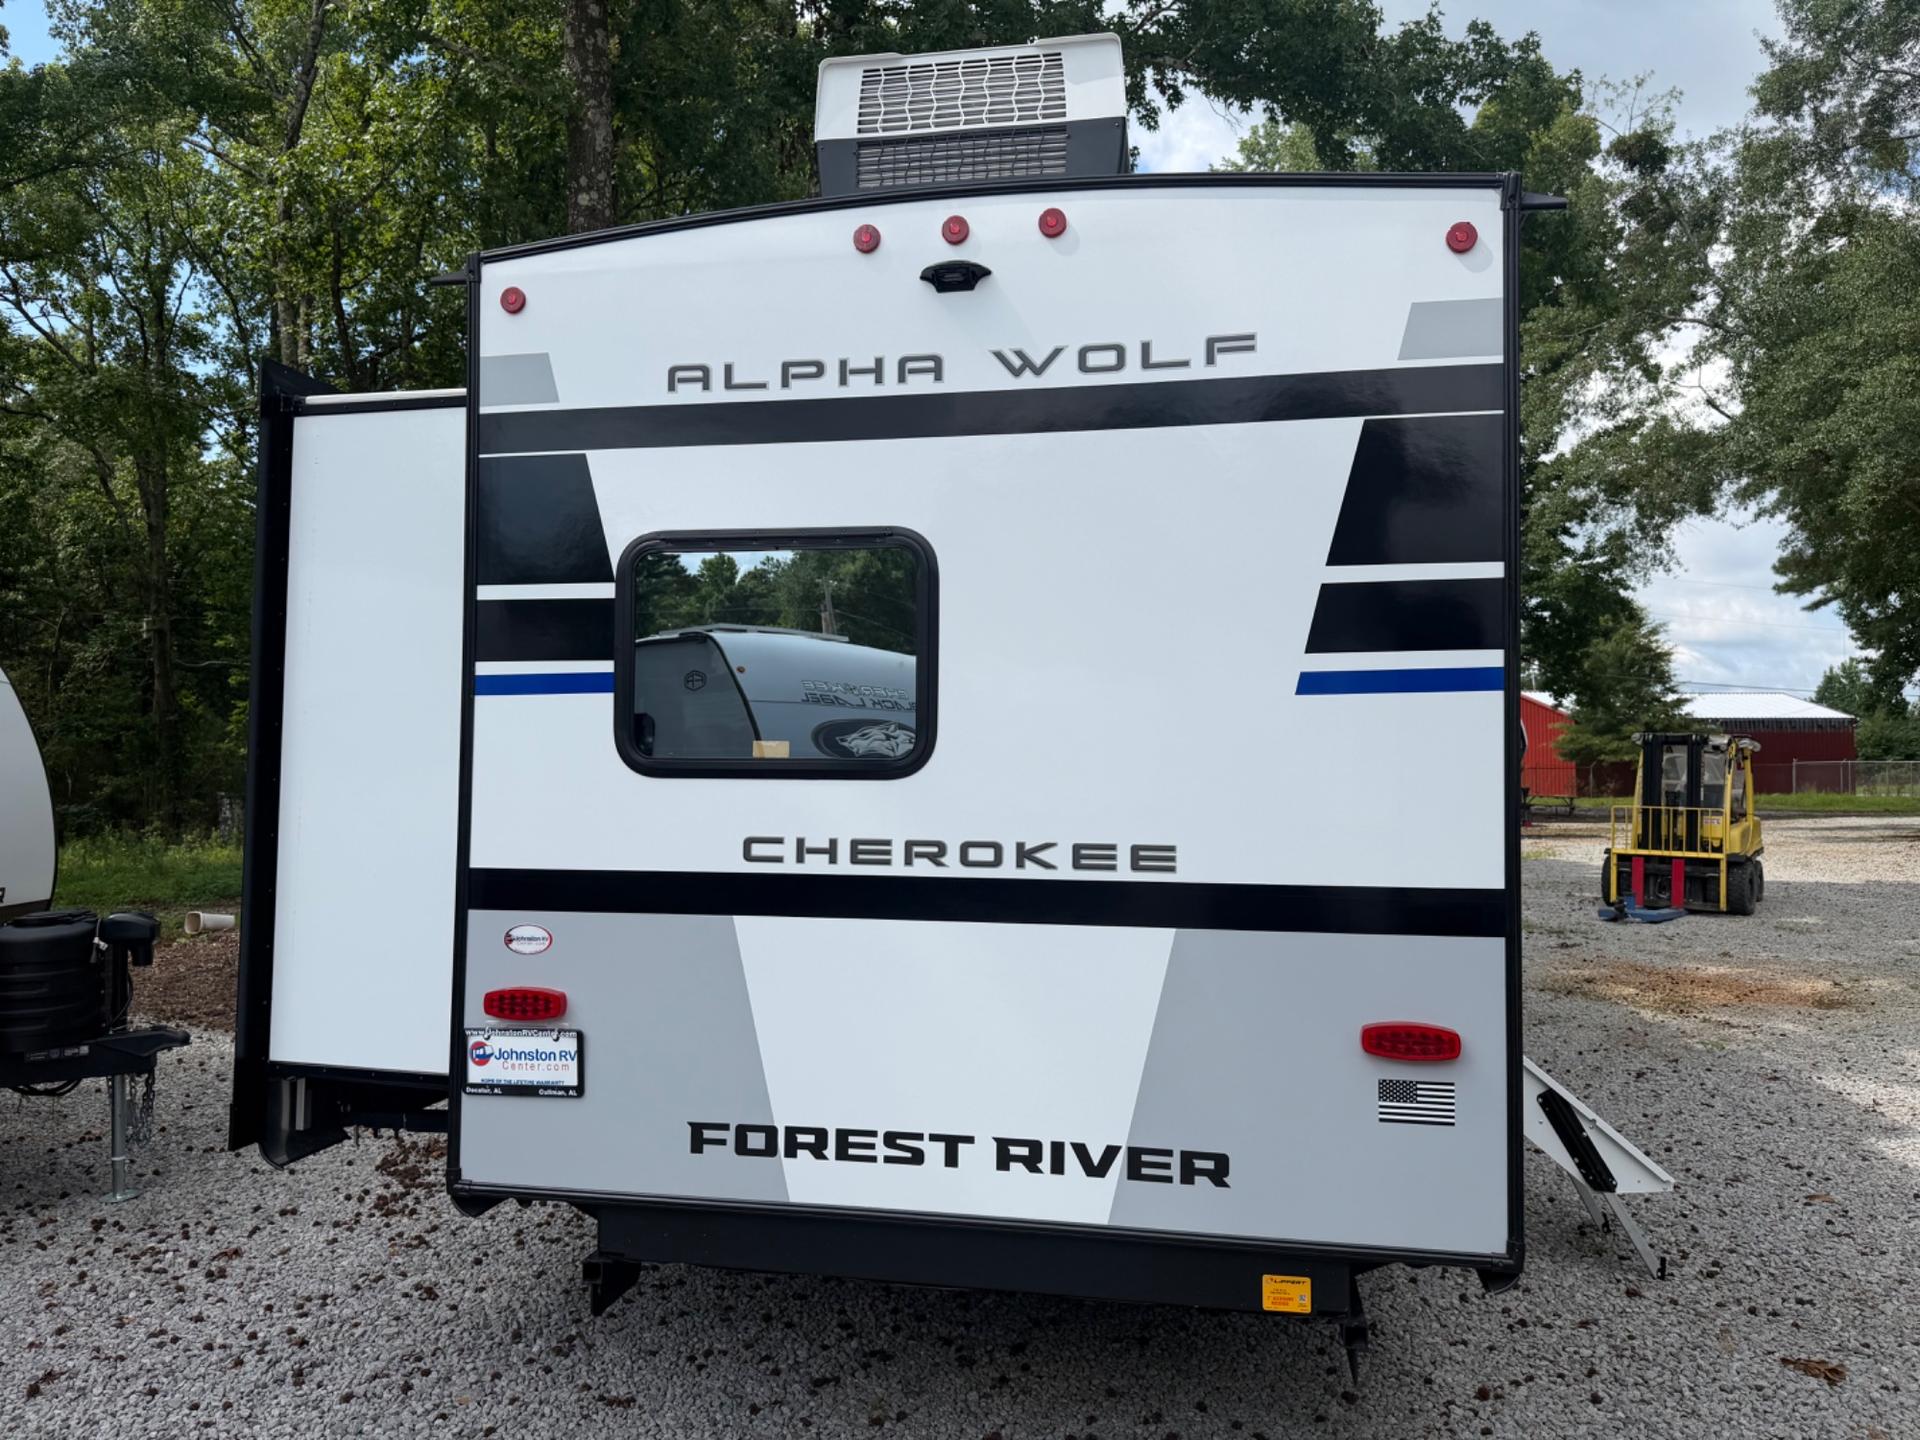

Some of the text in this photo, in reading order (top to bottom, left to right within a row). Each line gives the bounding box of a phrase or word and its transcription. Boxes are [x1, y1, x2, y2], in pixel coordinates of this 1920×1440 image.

[666, 332, 1259, 393] ALPHA WOLF
[742, 836, 1178, 873] CHEROKEE
[494, 1047, 577, 1061] Johnston RV
[502, 1061, 570, 1072] Center.com
[686, 1120, 1232, 1189] FOREST RIVER
